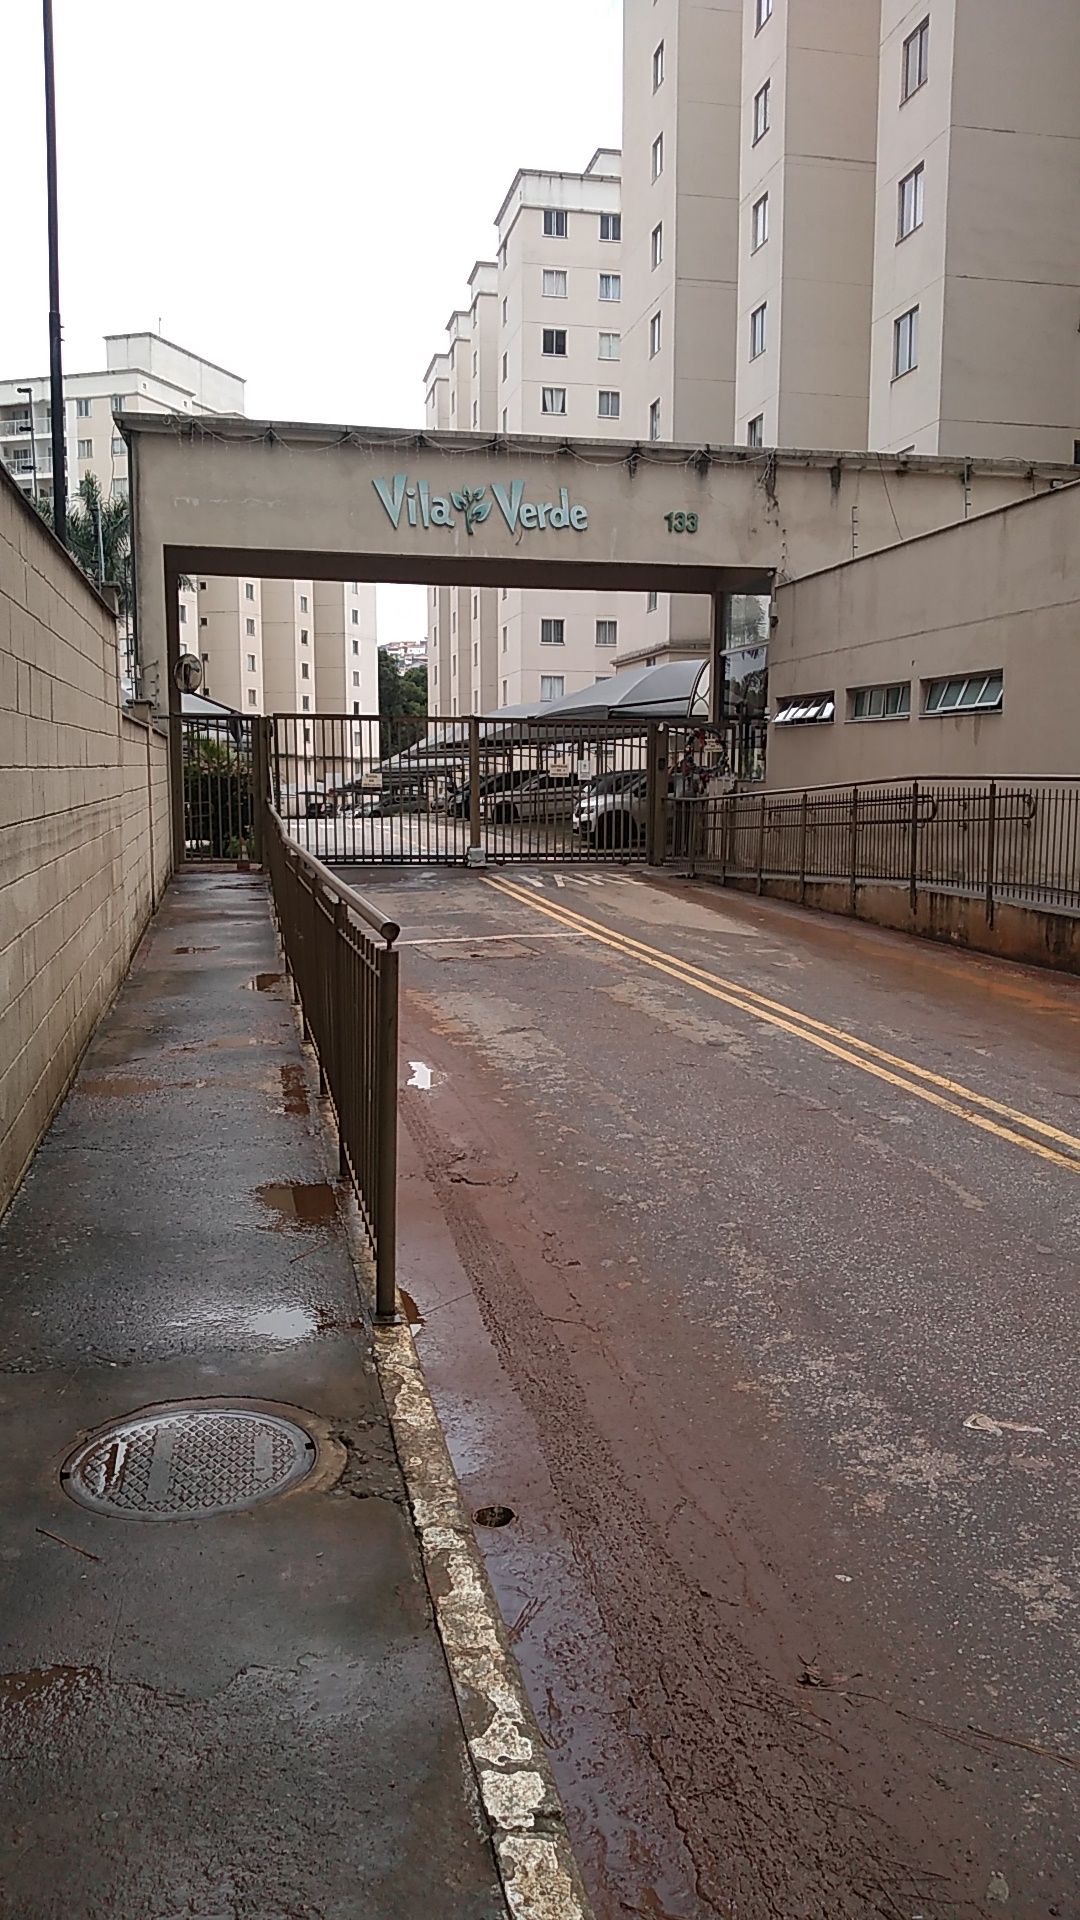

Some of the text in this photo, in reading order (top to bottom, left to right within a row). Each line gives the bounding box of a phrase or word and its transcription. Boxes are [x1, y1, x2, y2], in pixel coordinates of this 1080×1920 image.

[372, 473, 588, 534] Vila Verde
[664, 511, 699, 533] 133
[518, 873, 646, 888] PARE
